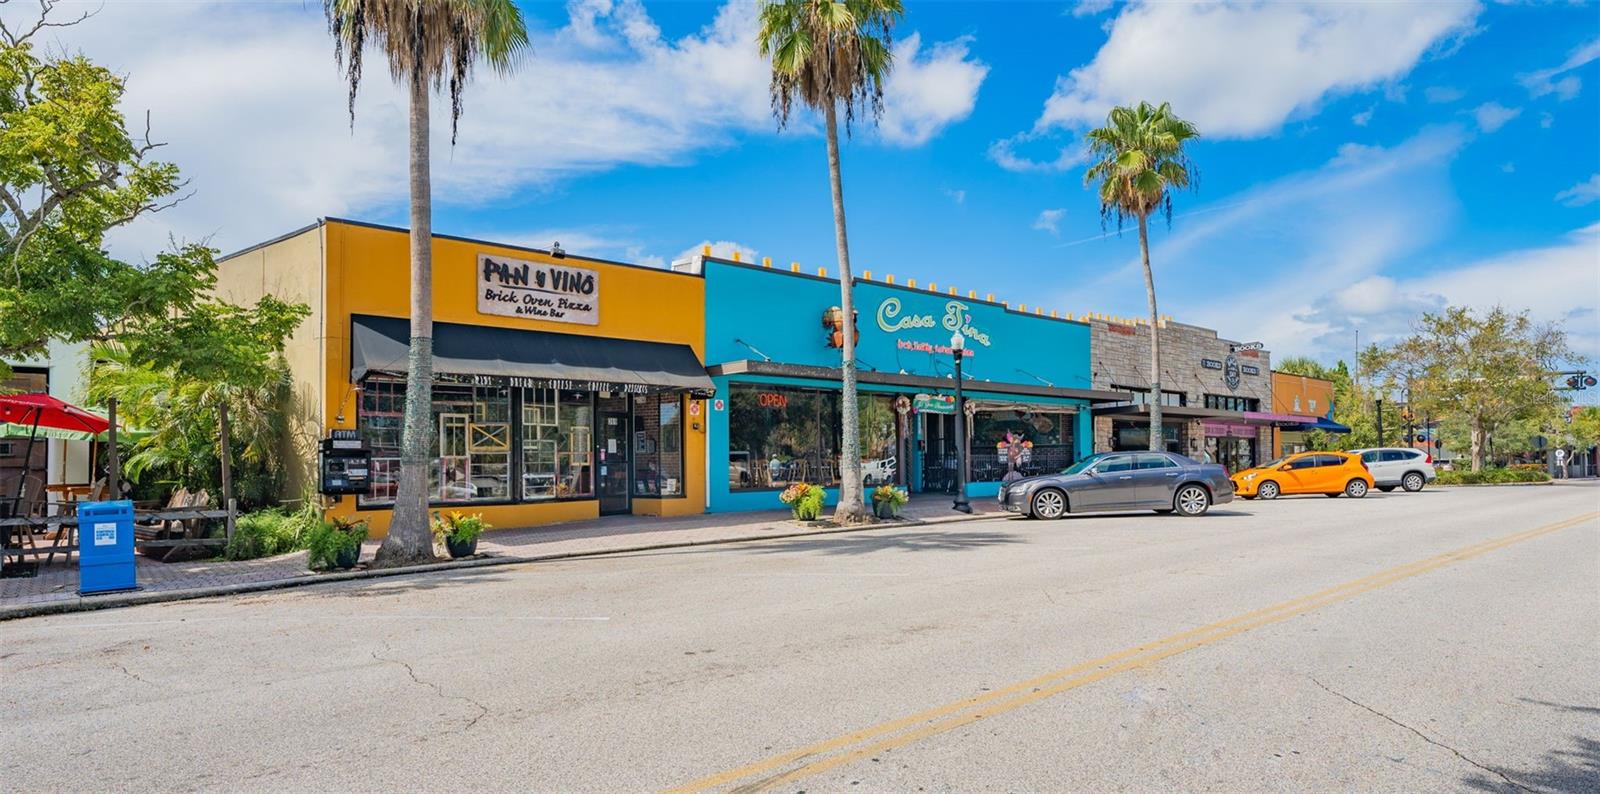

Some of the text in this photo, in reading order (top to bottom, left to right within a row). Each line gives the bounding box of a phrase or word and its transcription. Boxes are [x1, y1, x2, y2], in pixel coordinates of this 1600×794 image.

[484, 258, 530, 286] PAN
[485, 288, 592, 312] Brick Oven Pizza
[516, 306, 565, 318] & Wine Bar
[876, 297, 936, 332] Casa
[1234, 344, 1261, 352] BOOKS
[760, 393, 786, 408] OPEN
[334, 430, 356, 439] ATM
